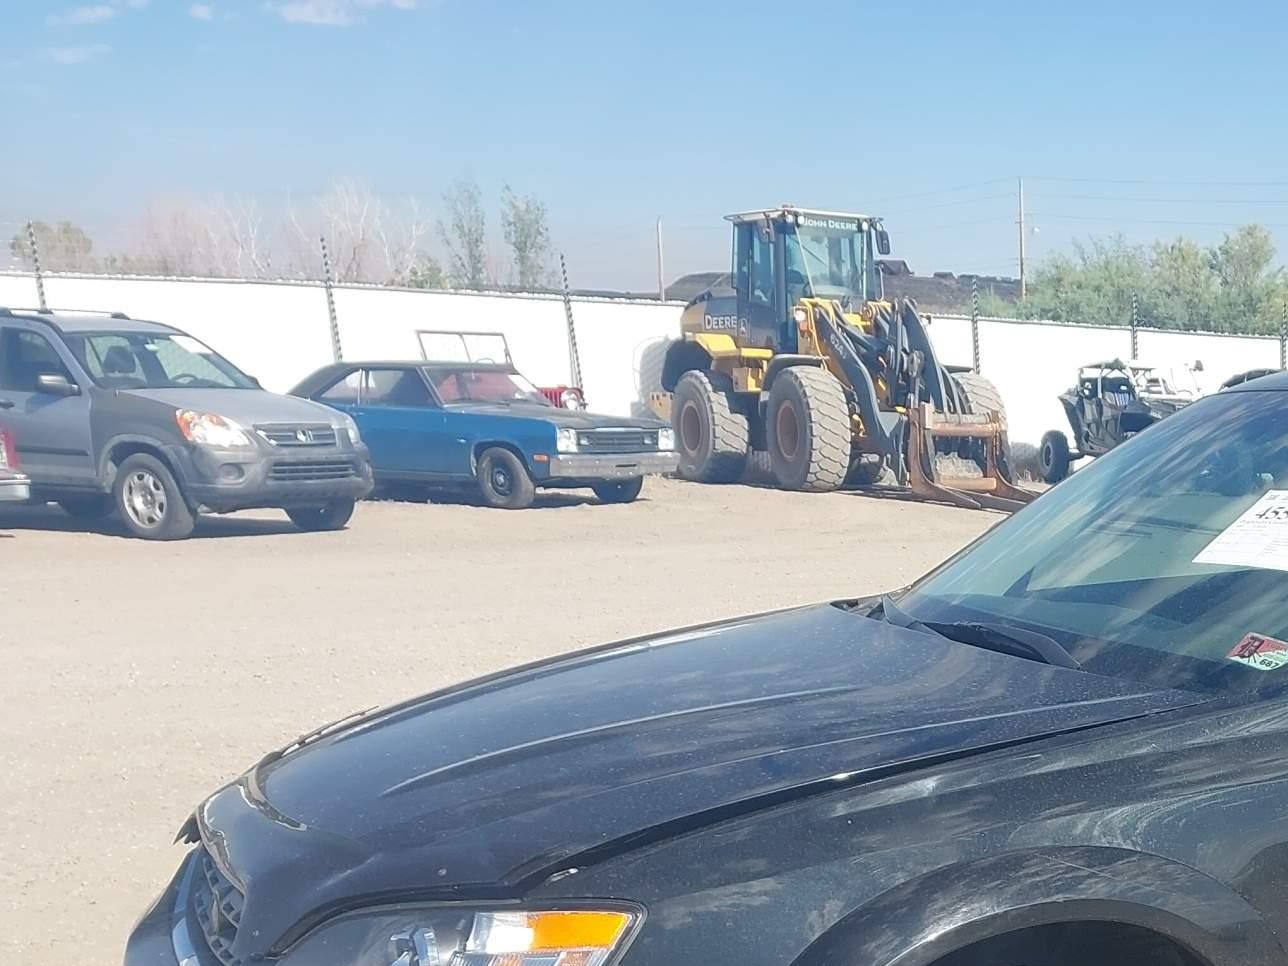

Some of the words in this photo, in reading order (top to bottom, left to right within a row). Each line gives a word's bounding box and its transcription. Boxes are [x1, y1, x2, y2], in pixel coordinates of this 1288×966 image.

[804, 218, 828, 228] JOHN
[828, 220, 858, 231] DEERE
[705, 314, 737, 329] DEERE
